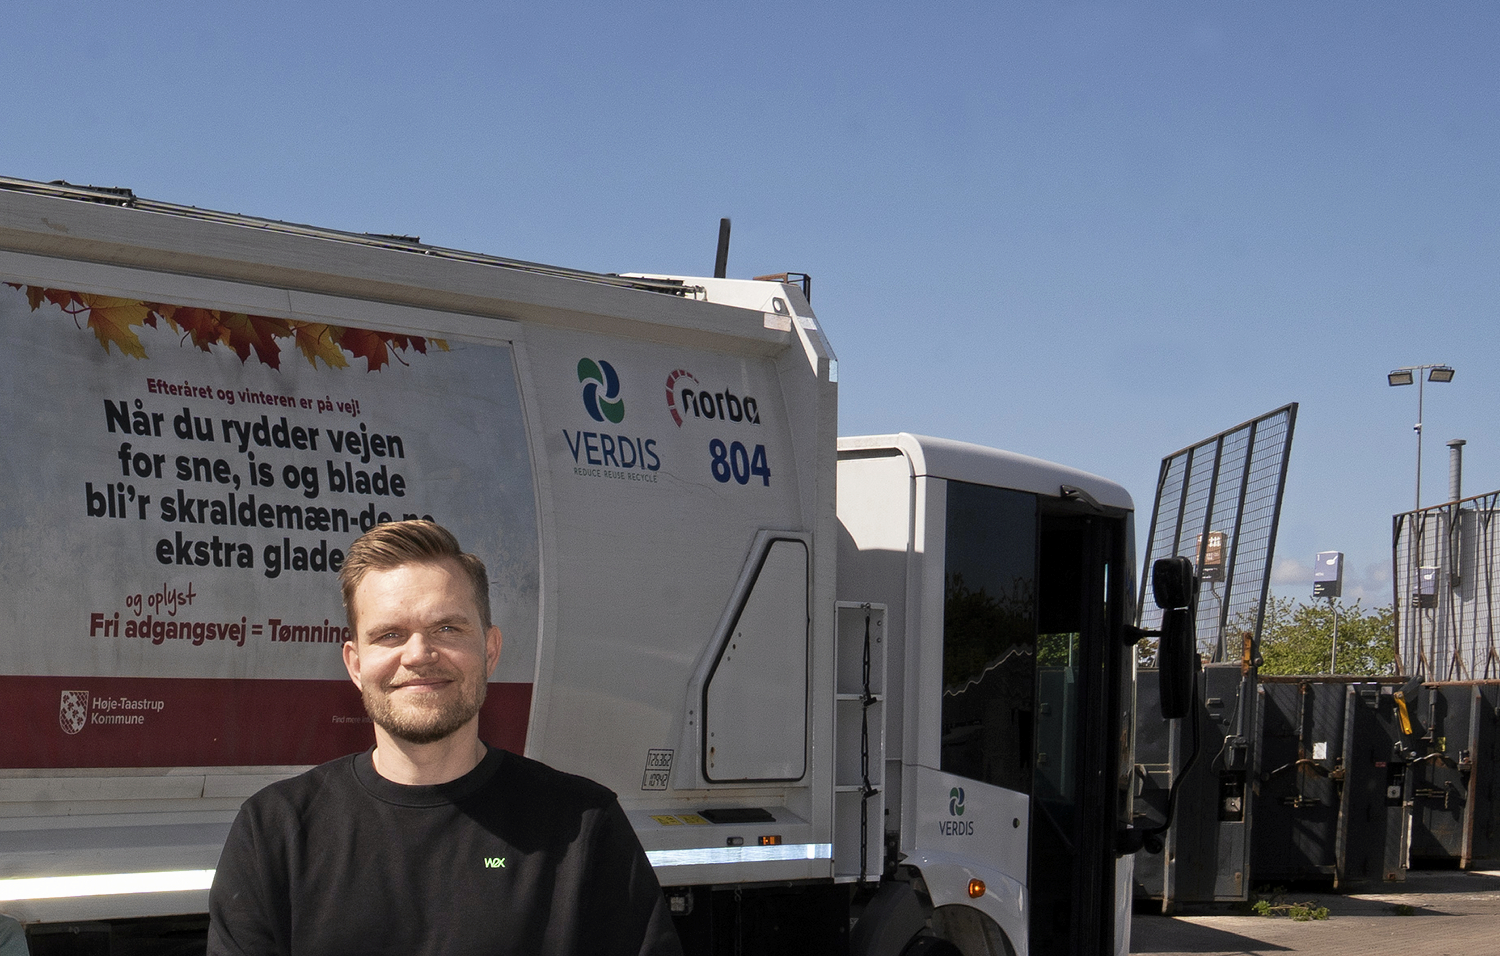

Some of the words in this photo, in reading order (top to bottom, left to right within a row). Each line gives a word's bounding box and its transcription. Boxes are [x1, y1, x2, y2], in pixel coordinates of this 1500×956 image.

[147, 378, 213, 400] Efteråret
[217, 386, 235, 405] og
[238, 387, 296, 408] vinteren
[300, 397, 313, 410] er
[317, 394, 333, 415] på
[336, 400, 361, 417] vej!
[681, 386, 761, 425] norba
[103, 398, 164, 438] Når
[173, 407, 214, 442] du
[221, 414, 319, 453] rydder
[326, 422, 405, 464] vejen
[562, 429, 661, 471] VERDIS
[118, 442, 166, 479] for
[175, 453, 241, 491] sne,
[248, 451, 275, 489] is
[282, 464, 319, 499] og
[327, 460, 407, 498] blade
[574, 467, 601, 478] REDUCE
[604, 470, 626, 480] REUSE
[627, 472, 658, 484] RECYCLE
[709, 438, 771, 487] 804
[155, 531, 254, 569] ekstra
[263, 537, 345, 578] glade
[126, 592, 142, 615] og
[148, 581, 197, 616] oplyst
[89, 612, 120, 638] Fri
[124, 615, 247, 647] adgangsvej
[91, 713, 145, 725] Kommune
[92, 697, 165, 713] Høje-Taastrup
[939, 821, 974, 836] VERDIS
